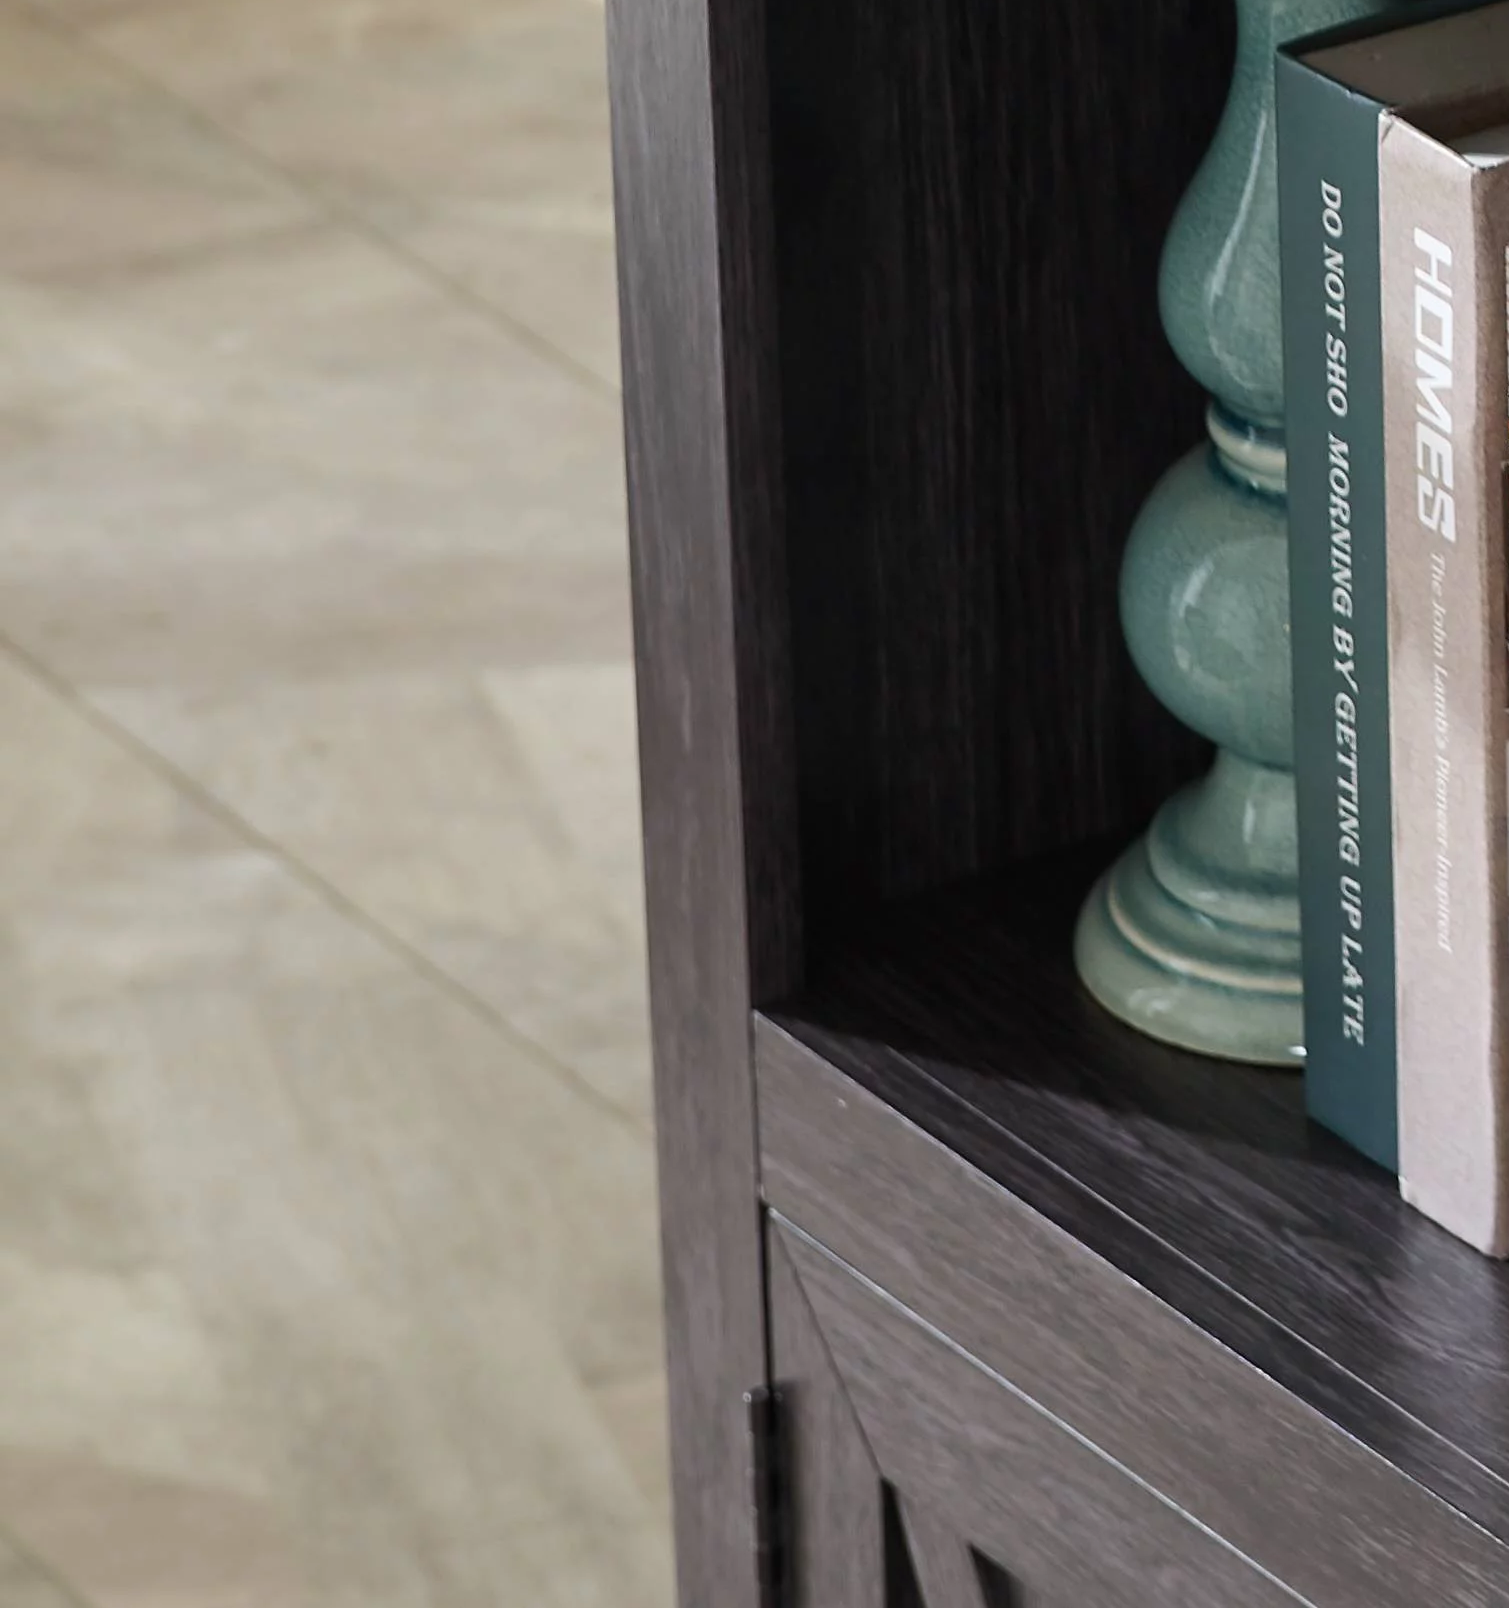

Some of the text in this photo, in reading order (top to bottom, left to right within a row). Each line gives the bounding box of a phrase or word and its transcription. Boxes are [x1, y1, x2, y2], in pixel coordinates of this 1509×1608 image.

[1413, 226, 1456, 545] HOMES
[1321, 180, 1364, 1047] DO NOT SHO MORNING BY GETTING UP LATE
[1430, 552, 1447, 598] The
